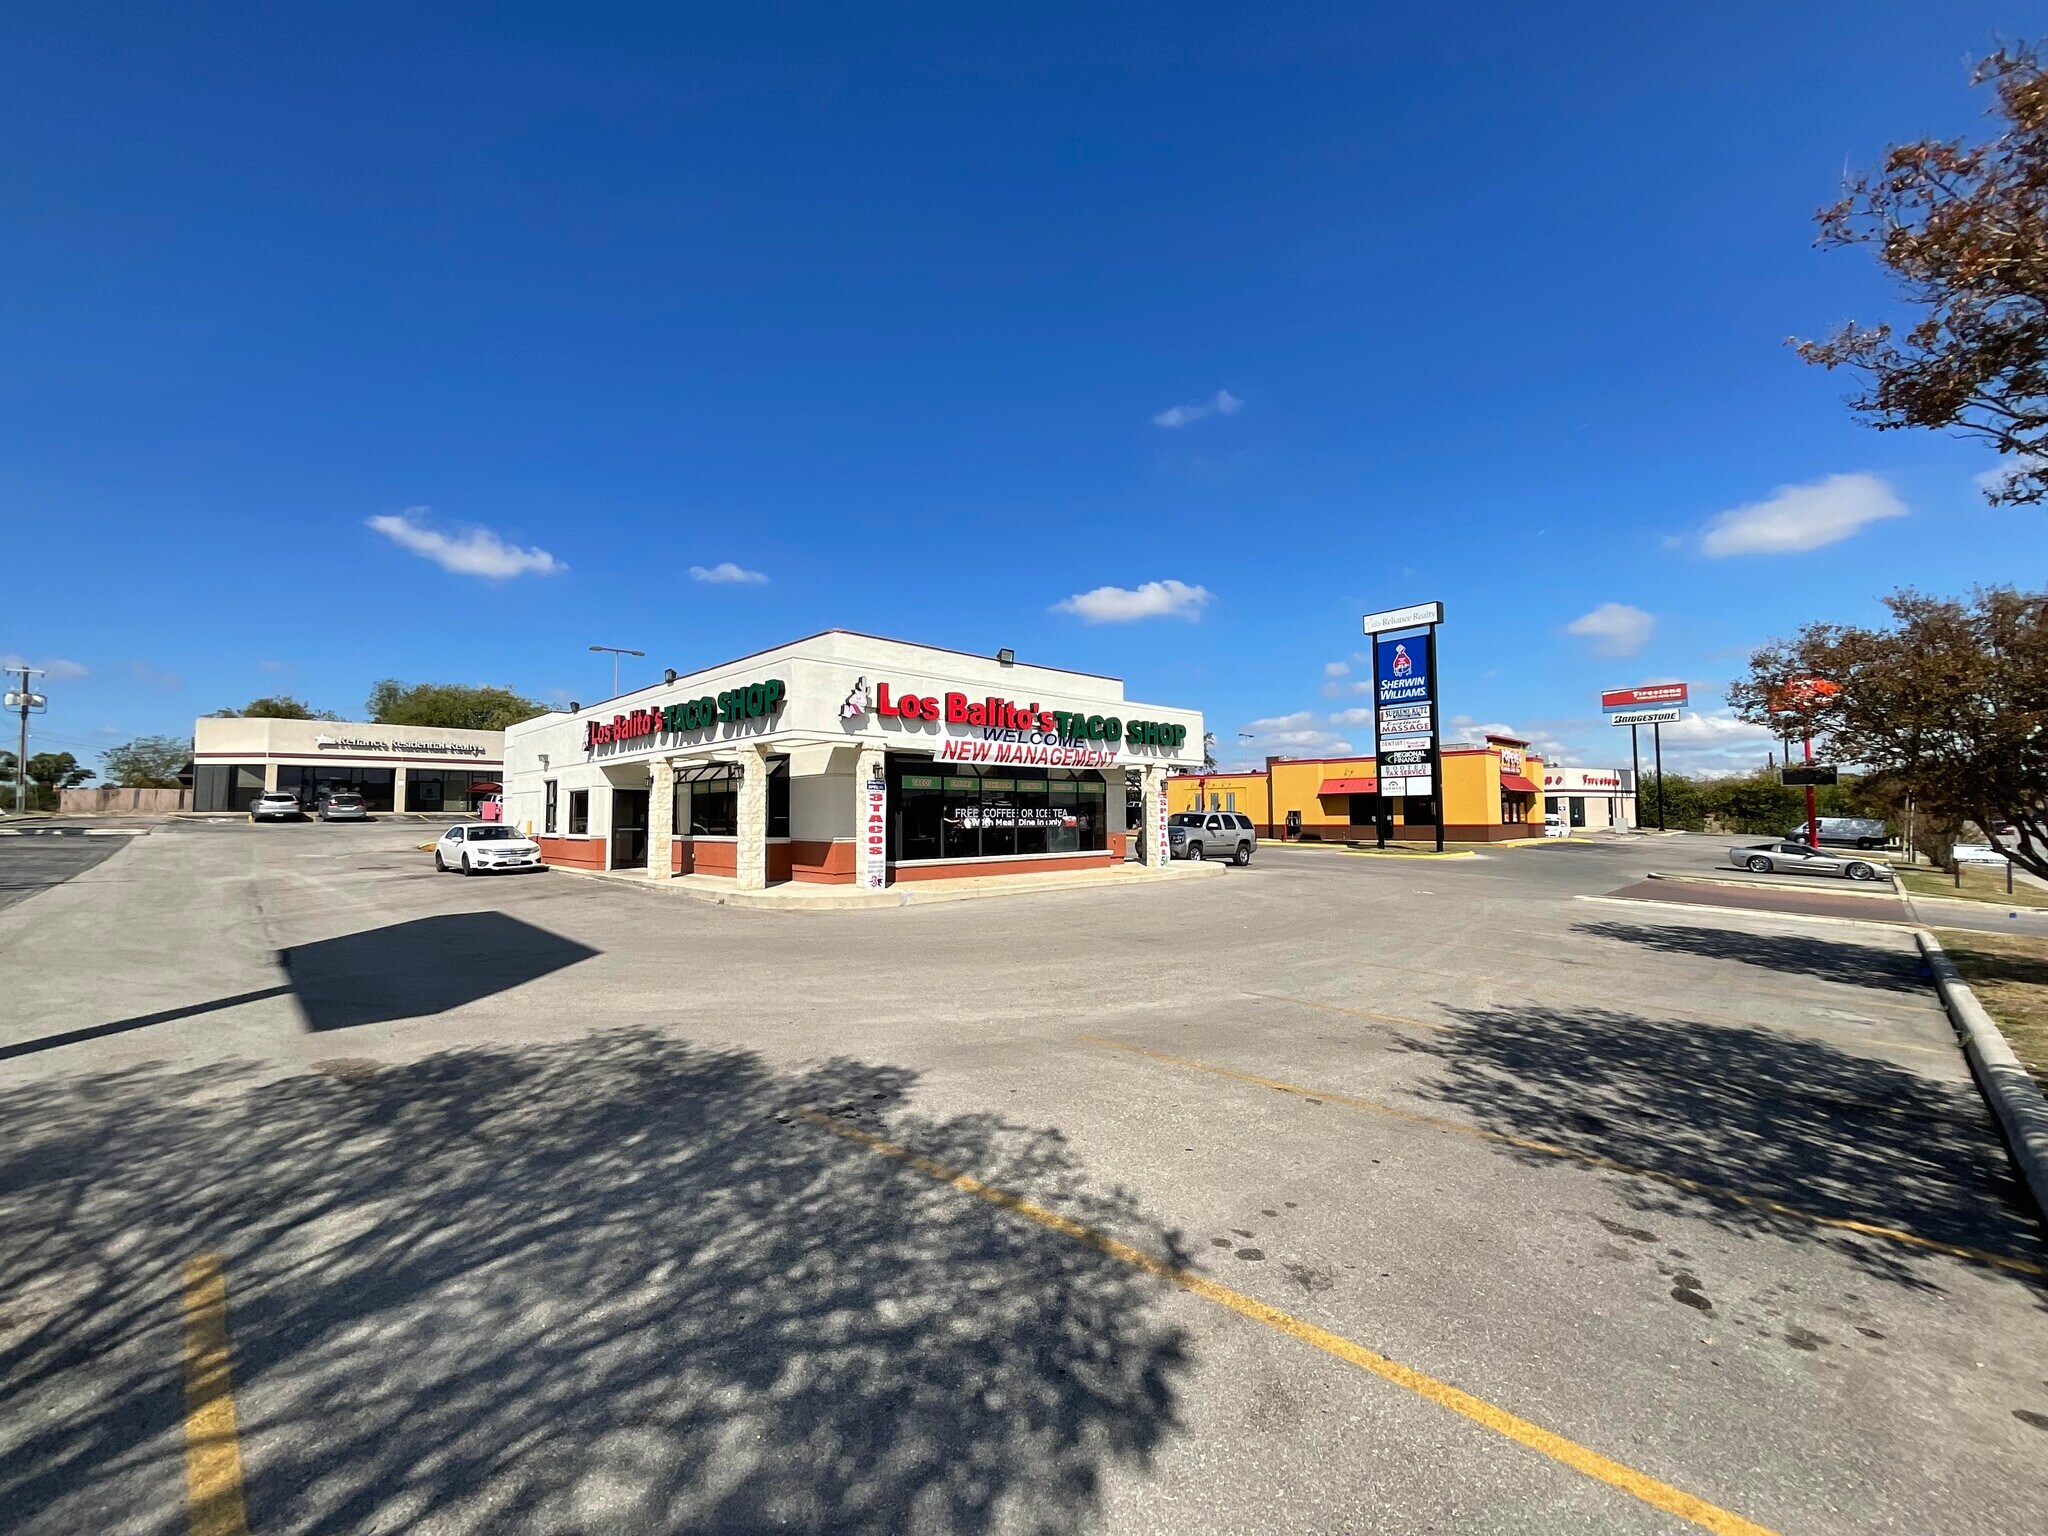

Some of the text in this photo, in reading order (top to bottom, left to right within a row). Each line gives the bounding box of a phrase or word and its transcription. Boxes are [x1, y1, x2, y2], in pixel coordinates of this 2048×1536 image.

[1382, 615, 1412, 626] Reliance
[1413, 610, 1436, 621] Realty
[1380, 676, 1426, 690] SHERWIN
[1380, 687, 1427, 701] WILLIAMS
[1632, 687, 1682, 698] Firestone
[589, 679, 786, 745] Los Balito's TACO SHOP
[877, 682, 1187, 747] Los Balito's TACO SHOP
[1613, 712, 1677, 724] BRIDGESTONE
[1381, 723, 1430, 733] MASSAGE
[982, 727, 1085, 749] WELCOME
[941, 740, 1118, 768] NEW MANAGEMENT
[1393, 750, 1427, 758] REGIONAL
[1393, 756, 1422, 764] FINANCE
[955, 808, 1068, 818] FREE COFFEE OR ICE TEA
[995, 818, 1015, 826] Meal
[1018, 818, 1035, 826] Dine
[1159, 799, 1168, 855] SPECIAL
[868, 804, 883, 855] TACOS
